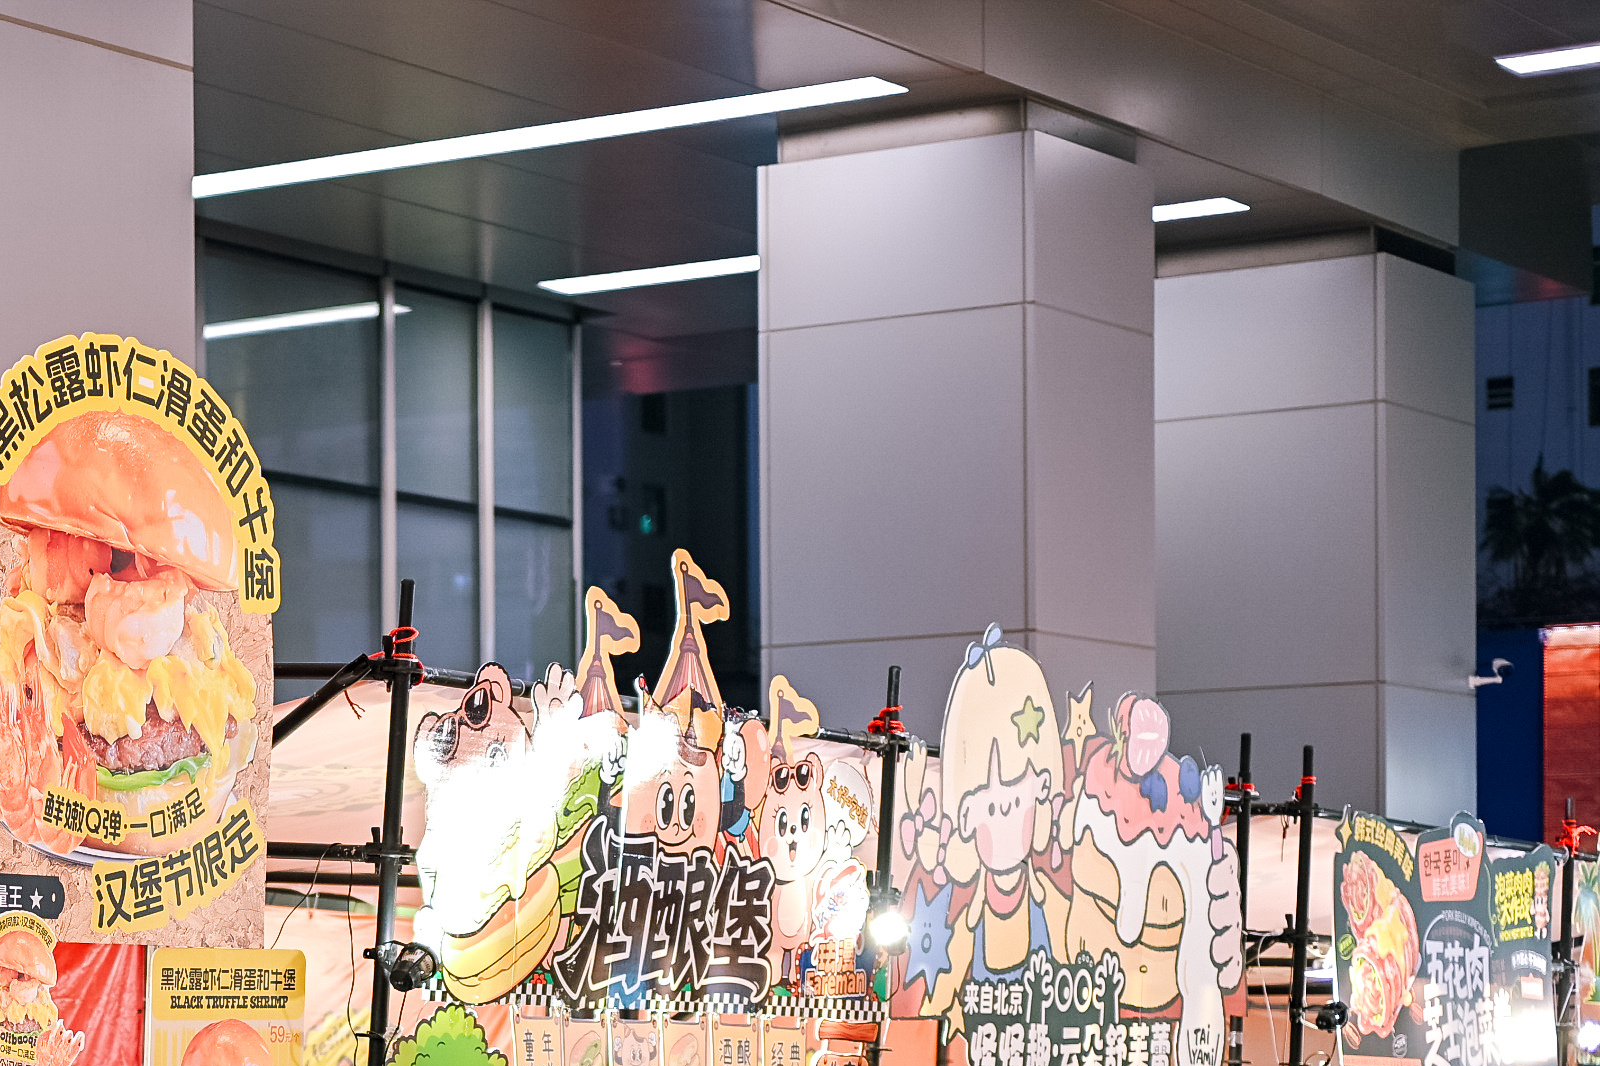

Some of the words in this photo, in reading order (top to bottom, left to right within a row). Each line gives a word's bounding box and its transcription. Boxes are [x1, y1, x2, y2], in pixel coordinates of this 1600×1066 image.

[95, 809, 259, 929] 汉堡节限定
[160, 968, 297, 992] 黑松露虾仁滑蛋和牛堡
[1426, 934, 1491, 999] 五花肉
[170, 995, 204, 1010] BLACK
[205, 995, 248, 1010] TRUFFLE
[250, 995, 289, 1010] SHRIMP
[963, 981, 1025, 1016] 来自北京
